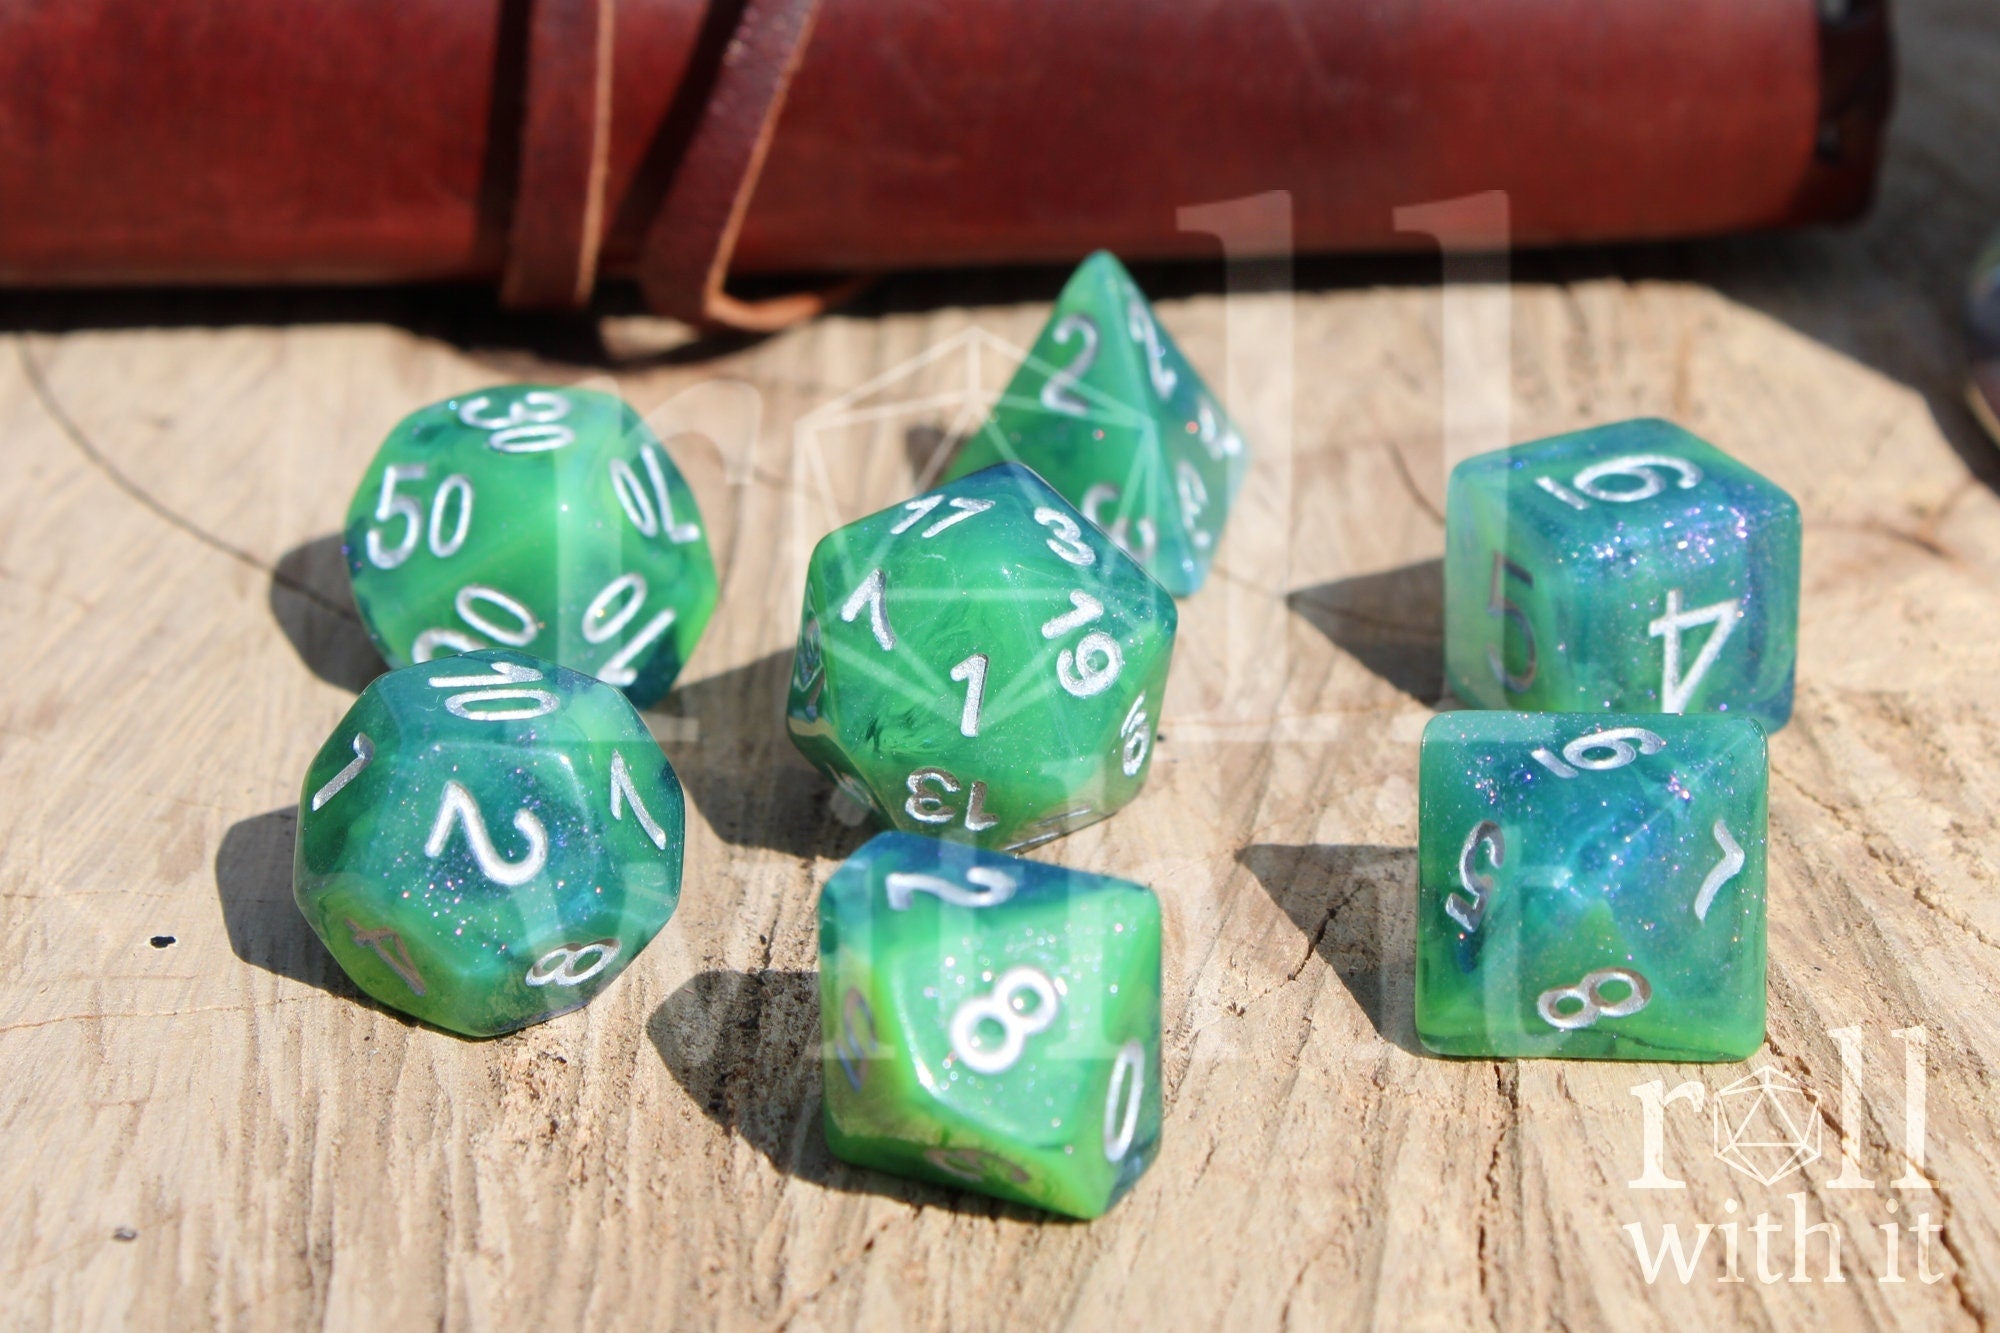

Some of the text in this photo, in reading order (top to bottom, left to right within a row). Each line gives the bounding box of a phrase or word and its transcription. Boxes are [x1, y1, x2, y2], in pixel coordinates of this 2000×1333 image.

[1040, 312, 1100, 416] 2
[458, 391, 575, 454] 30
[366, 463, 475, 569] 50
[608, 444, 701, 545] 70
[890, 494, 996, 539] 17
[1033, 506, 1097, 566] 3
[581, 572, 677, 687] 10
[1040, 589, 1123, 698] 19
[1486, 550, 1537, 694] 5
[1649, 588, 1741, 714] 4
[428, 661, 560, 721] 10
[949, 652, 990, 738] 1
[424, 780, 549, 886] 2
[904, 765, 999, 832] 13
[884, 866, 1017, 911] 2
[1445, 820, 1505, 933] 5
[525, 938, 622, 987] 8
[1537, 967, 1653, 1029] 8
[949, 966, 1059, 1075] 8
[1104, 1039, 1145, 1163] 0
